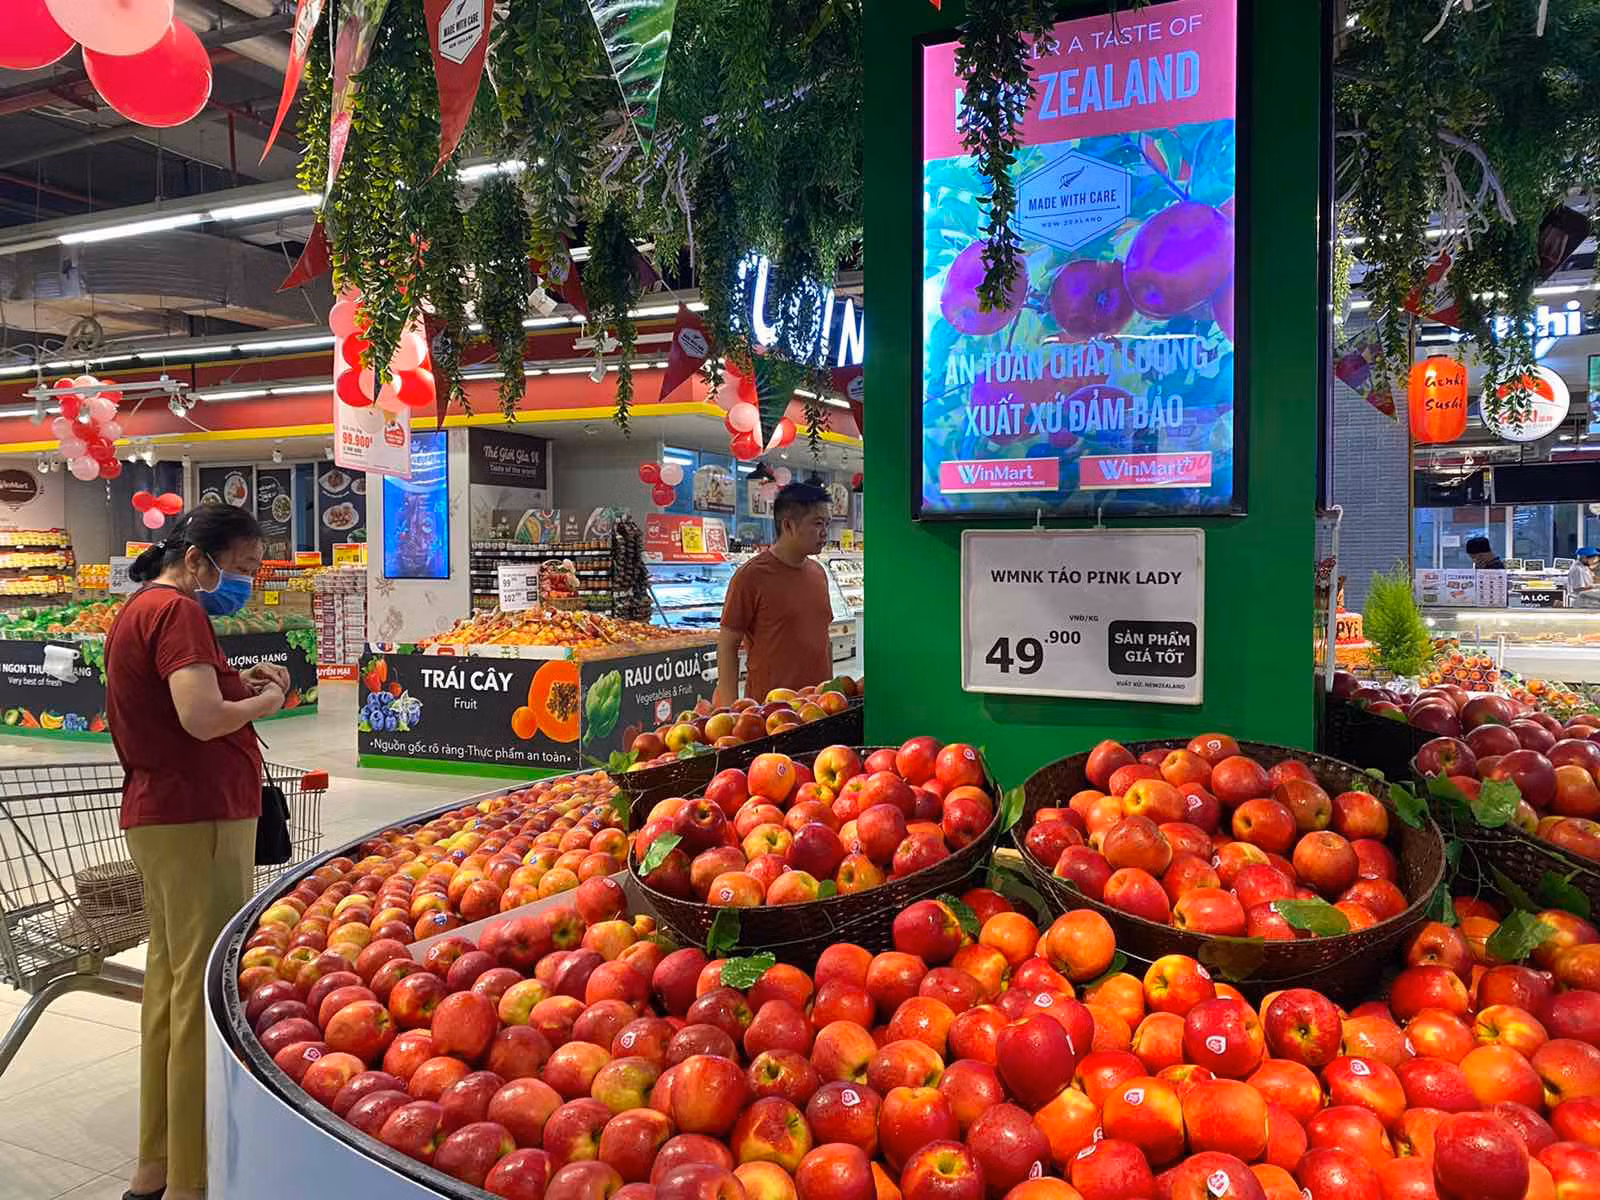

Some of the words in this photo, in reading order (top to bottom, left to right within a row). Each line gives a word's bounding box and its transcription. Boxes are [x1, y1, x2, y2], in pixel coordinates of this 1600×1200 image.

[443, 24, 455, 37] MADE
[455, 19, 467, 31] WITH
[467, 11, 480, 26] CARE
[1067, 34, 1084, 54] A
[1090, 21, 1163, 49] TASTE
[1169, 14, 1203, 36] OF
[1038, 50, 1200, 121] ZEALAND
[1028, 196, 1057, 211] MADE
[1060, 192, 1086, 208] WITH
[1089, 188, 1117, 204] CARE
[1063, 216, 1103, 226] ZEALAND
[945, 352, 975, 385] AN
[965, 393, 1025, 437] XUẤT
[1029, 391, 1066, 434] XỨ
[1069, 389, 1125, 432] ĐẢM
[1131, 385, 1184, 432] BẢO
[1425, 396, 1463, 411] Sushi
[958, 464, 1034, 485] WinMart
[991, 570, 1044, 583] WMNK
[1049, 566, 1082, 583] TÁO
[1087, 571, 1131, 584] PINK
[1135, 571, 1182, 585] LADY
[1114, 632, 1144, 646] SẢN
[1148, 631, 1191, 647] PHẨM
[985, 637, 1044, 675] 49
[1125, 648, 1151, 664] GIÁ
[1155, 648, 1185, 664] TỐT
[2, 663, 27, 673] NGON
[421, 666, 465, 689] TRÁI
[470, 667, 513, 692] CÂY
[625, 665, 652, 688] RAU
[655, 657, 672, 682] CỦ
[675, 652, 701, 678] QUẢ
[8, 677, 22, 686] Very
[23, 678, 37, 686] best
[45, 679, 63, 687] fresh
[454, 698, 477, 710] Fruit
[635, 690, 672, 706] Vegetables
[672, 686, 678, 697] &
[678, 683, 693, 696] Fruit
[408, 740, 427, 754] gốc
[428, 743, 440, 754] rõ
[495, 747, 524, 760] phẩm
[527, 752, 540, 761] an
